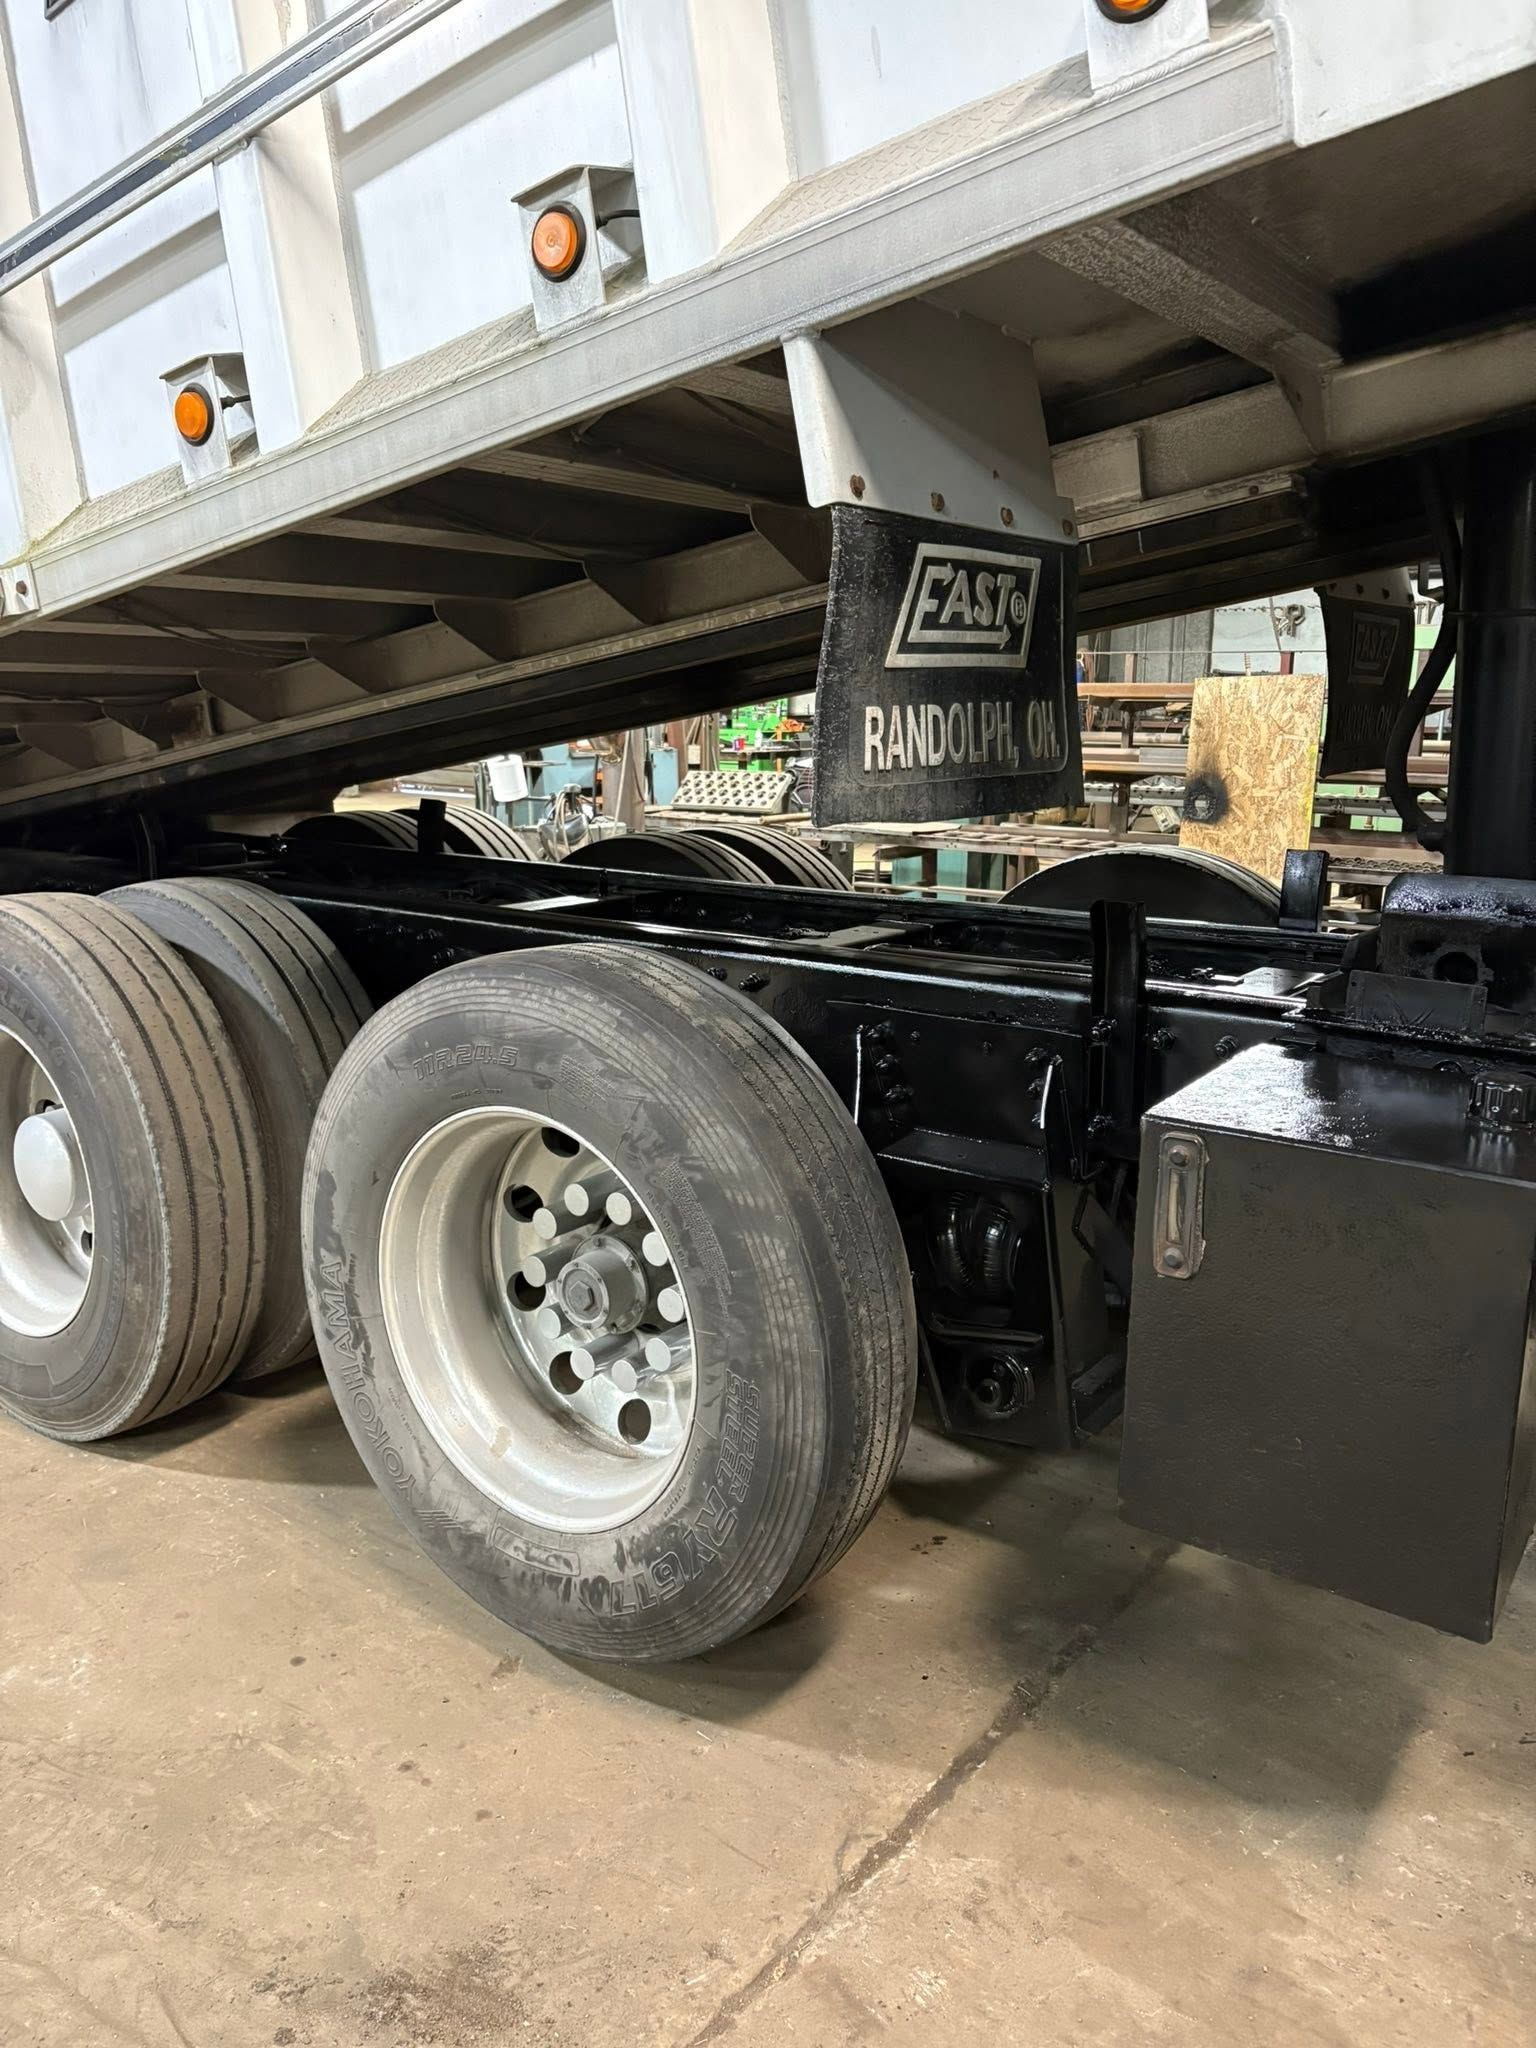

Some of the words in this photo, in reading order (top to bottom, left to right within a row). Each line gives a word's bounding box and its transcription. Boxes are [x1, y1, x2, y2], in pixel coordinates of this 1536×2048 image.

[863, 702, 1020, 772] RANDOLPH,
[412, 1044, 519, 1080] 11R24.5
[320, 1261, 417, 1503] YOKOHAMA
[715, 1367, 744, 1480] STEEL
[729, 1379, 760, 1503] SUPER
[609, 1485, 738, 1617] RY617
